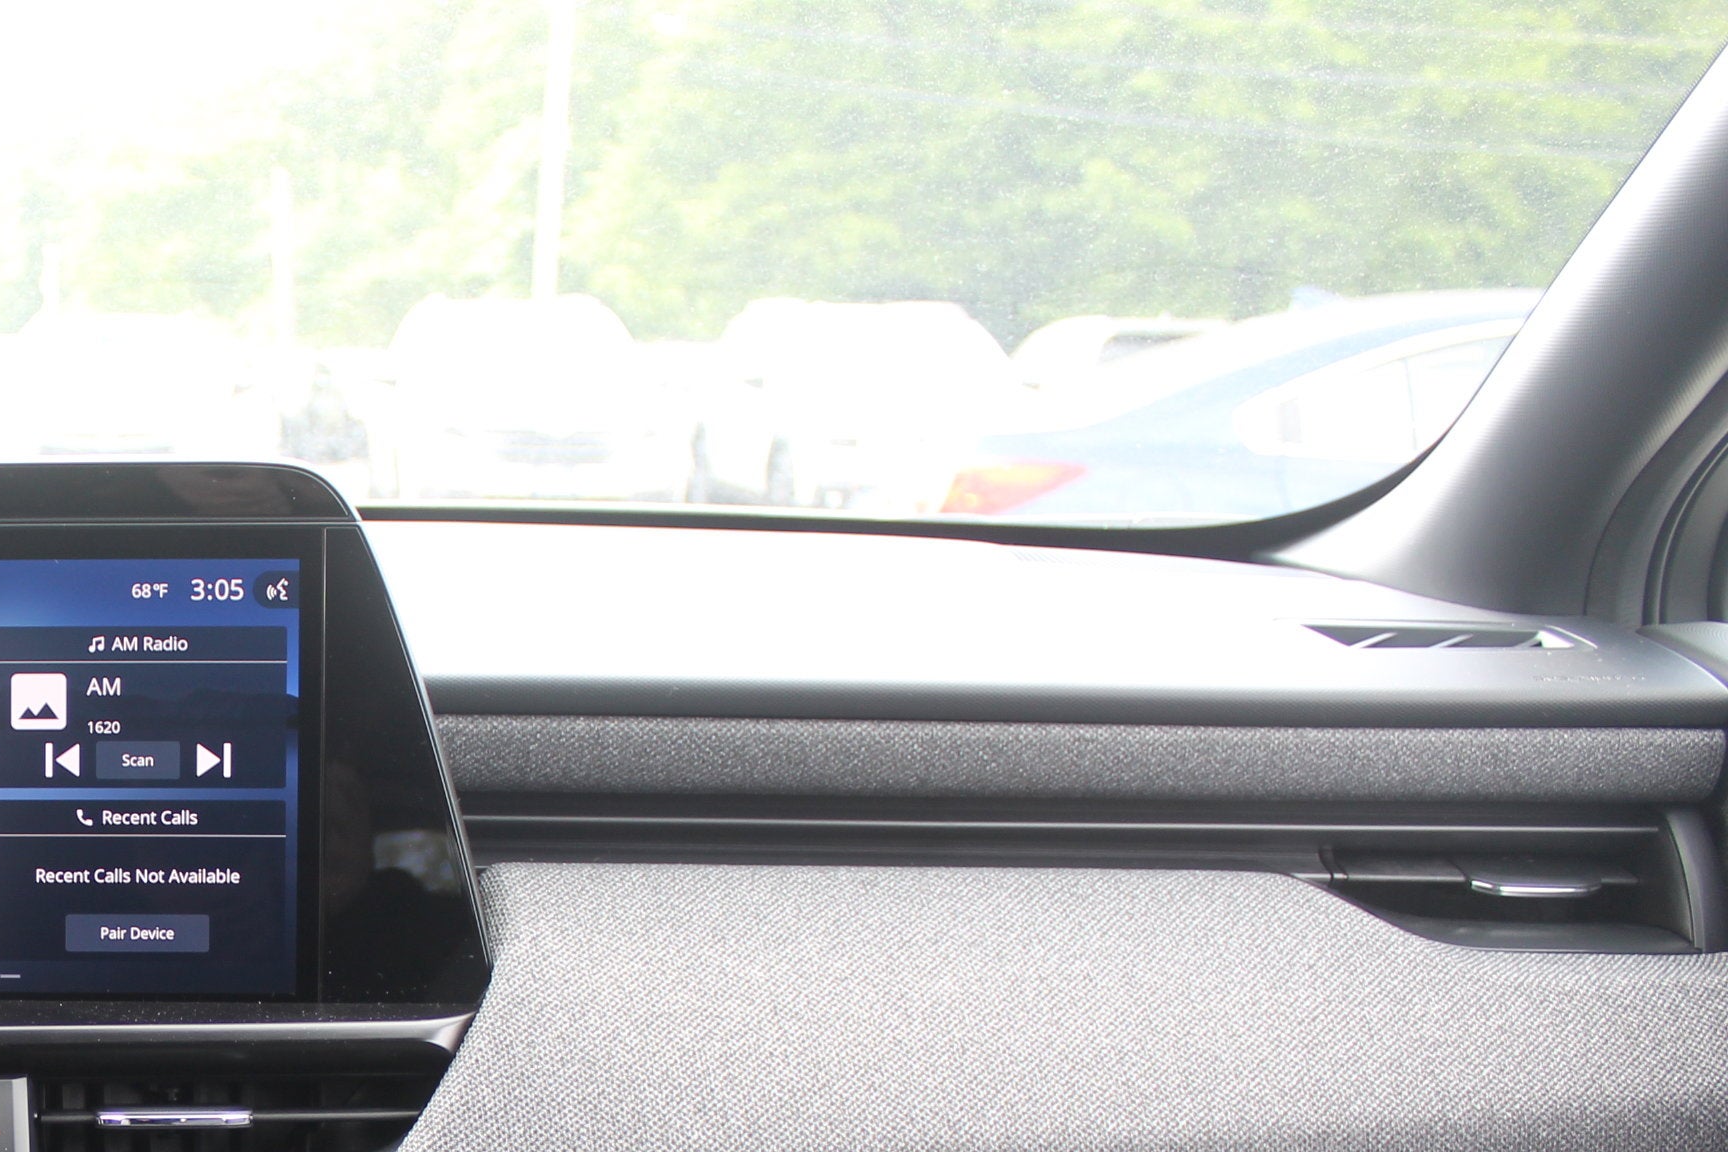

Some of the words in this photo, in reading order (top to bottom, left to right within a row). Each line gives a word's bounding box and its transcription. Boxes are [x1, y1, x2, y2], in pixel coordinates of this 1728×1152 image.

[131, 583, 169, 599] 68°F
[190, 578, 245, 602] 3:05
[111, 636, 138, 651] AM
[143, 635, 189, 652] Radio
[86, 677, 122, 697] AM
[87, 720, 122, 735] 1620
[121, 753, 155, 768] Scan
[101, 809, 157, 826] Recent
[160, 809, 199, 826] Calls
[35, 868, 91, 884] Recent
[93, 868, 131, 884] Calls
[135, 868, 165, 884] Not
[168, 867, 241, 885] Available
[100, 926, 127, 941] Pair
[130, 926, 175, 941] Device
